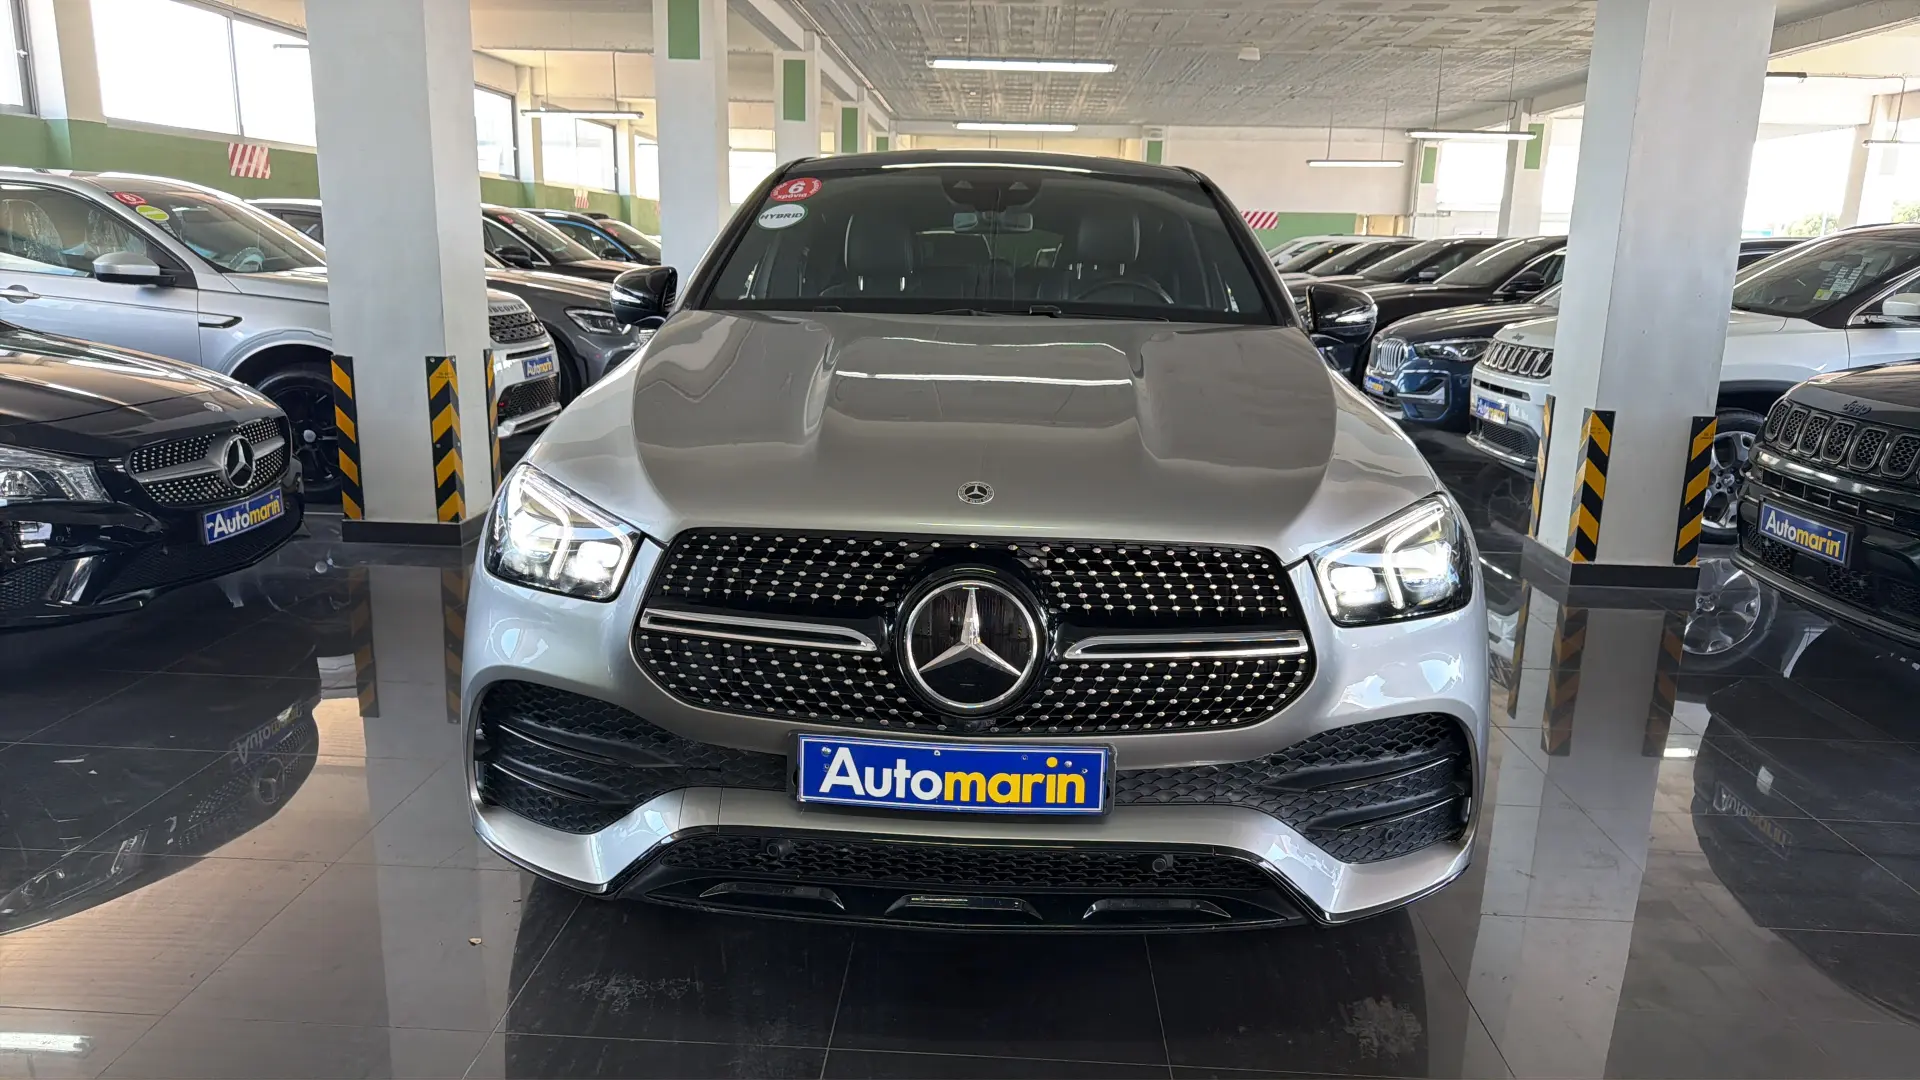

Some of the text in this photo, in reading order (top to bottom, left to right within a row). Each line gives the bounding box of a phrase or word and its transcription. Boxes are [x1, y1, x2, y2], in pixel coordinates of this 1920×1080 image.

[788, 182, 806, 194] 6
[760, 212, 803, 220] HYBRID
[213, 494, 280, 539] Automarin
[1765, 510, 1840, 558] Automarin
[818, 746, 1085, 804] Automarin
